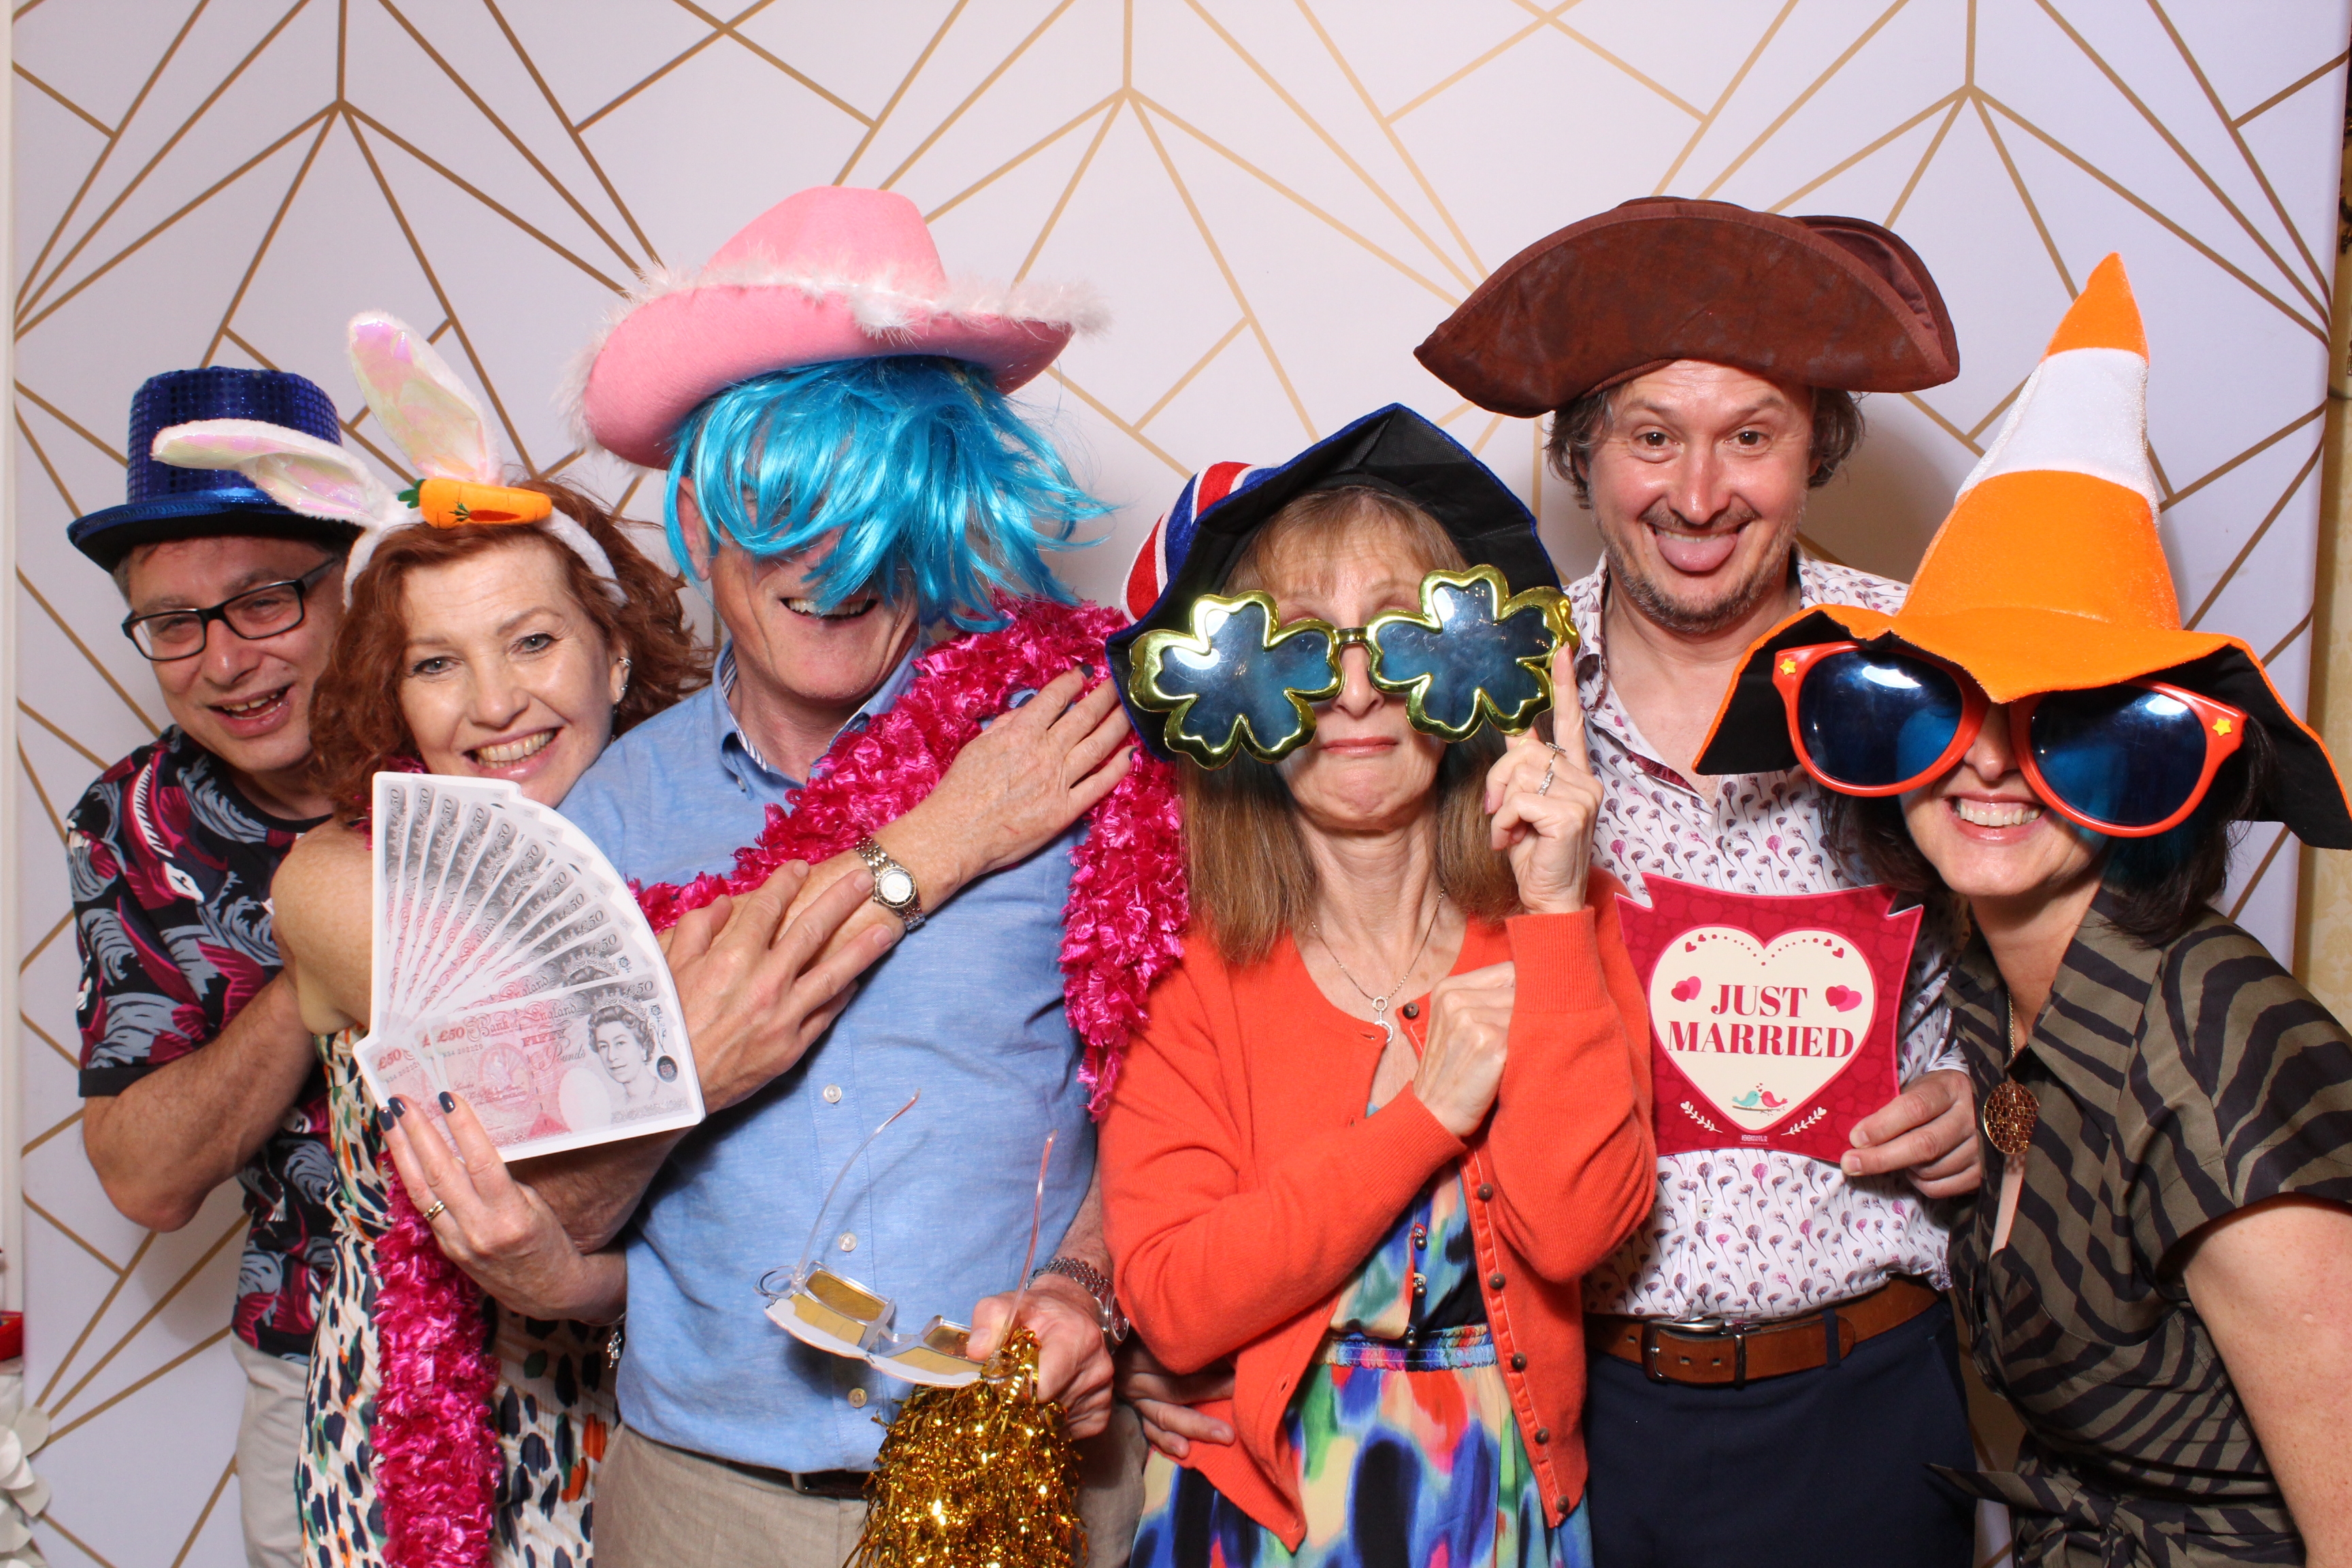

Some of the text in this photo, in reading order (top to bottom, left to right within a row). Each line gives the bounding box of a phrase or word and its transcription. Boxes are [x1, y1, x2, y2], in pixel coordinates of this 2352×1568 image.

[561, 893, 585, 918] £50
[578, 910, 604, 934] £50
[592, 933, 617, 954] £50
[625, 980, 654, 996] £50
[1710, 984, 1808, 1017] JUST
[463, 1011, 510, 1042] Bank
[519, 998, 577, 1024] England
[437, 1026, 466, 1043] £50
[521, 1028, 567, 1047] FIFTY
[1667, 1020, 1854, 1058] MARRIED
[378, 1049, 402, 1071] £50
[529, 1037, 586, 1071] Pounds
